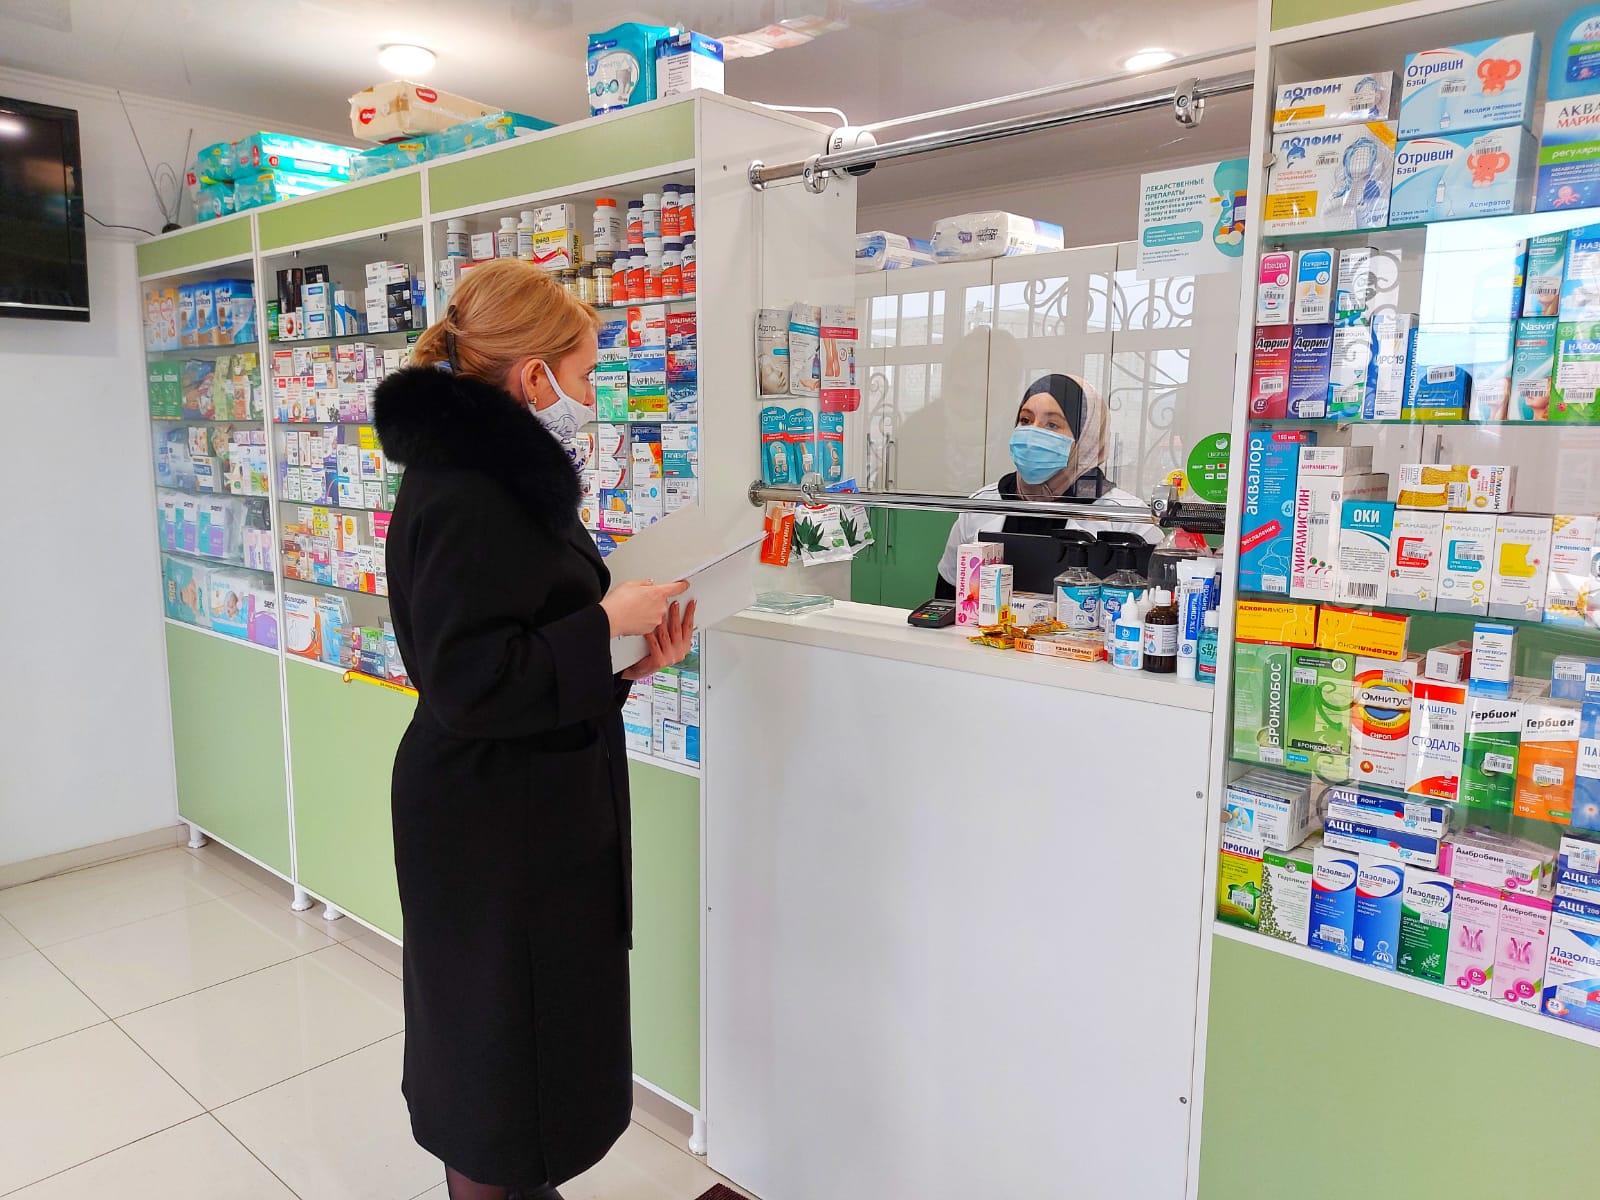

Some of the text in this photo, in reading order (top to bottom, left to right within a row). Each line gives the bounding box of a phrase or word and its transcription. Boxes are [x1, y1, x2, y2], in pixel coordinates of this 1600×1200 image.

[1408, 59, 1464, 78] Отривин
[1284, 84, 1342, 99] ДОЛФИН
[1280, 134, 1341, 151] ДОЛФИН
[1398, 150, 1454, 166] Отривин
[1146, 179, 1205, 193] ЛЕКАРСТВЕННЫЕ
[1145, 190, 1186, 202] ПРЕПАРАТЫ
[1579, 240, 1600, 250] НАЗ
[1521, 322, 1554, 331] Nasivin
[1257, 337, 1290, 353] Африн
[1295, 337, 1329, 352] Африн
[1246, 438, 1265, 517] аквалор
[1353, 509, 1381, 524] ОКИ
[1294, 489, 1312, 574] МИРАМИСТИН
[1269, 662, 1282, 745] БРОНХОБОС
[1361, 691, 1409, 706] Омнитус
[1471, 709, 1517, 724] Гербион
[1526, 719, 1575, 730] Гербион
[1370, 731, 1393, 740] СИРОП
[1411, 735, 1460, 754] СТОДАЛЬ
[1334, 791, 1358, 804] АЦЦ
[1328, 820, 1354, 833] АЦЦ
[1222, 841, 1260, 858] ПРОСПАН
[1455, 846, 1503, 863] Амбробене
[1316, 865, 1352, 879] Лазолван
[1359, 870, 1396, 885] Лазолван
[1562, 875, 1590, 889] АЦЦ
[1406, 886, 1445, 902] Лазолван
[1455, 892, 1498, 909] Амбробене
[1503, 904, 1547, 920] Амбробене
[1558, 899, 1588, 914] АЦЦ
[1549, 955, 1574, 968] МАКС
